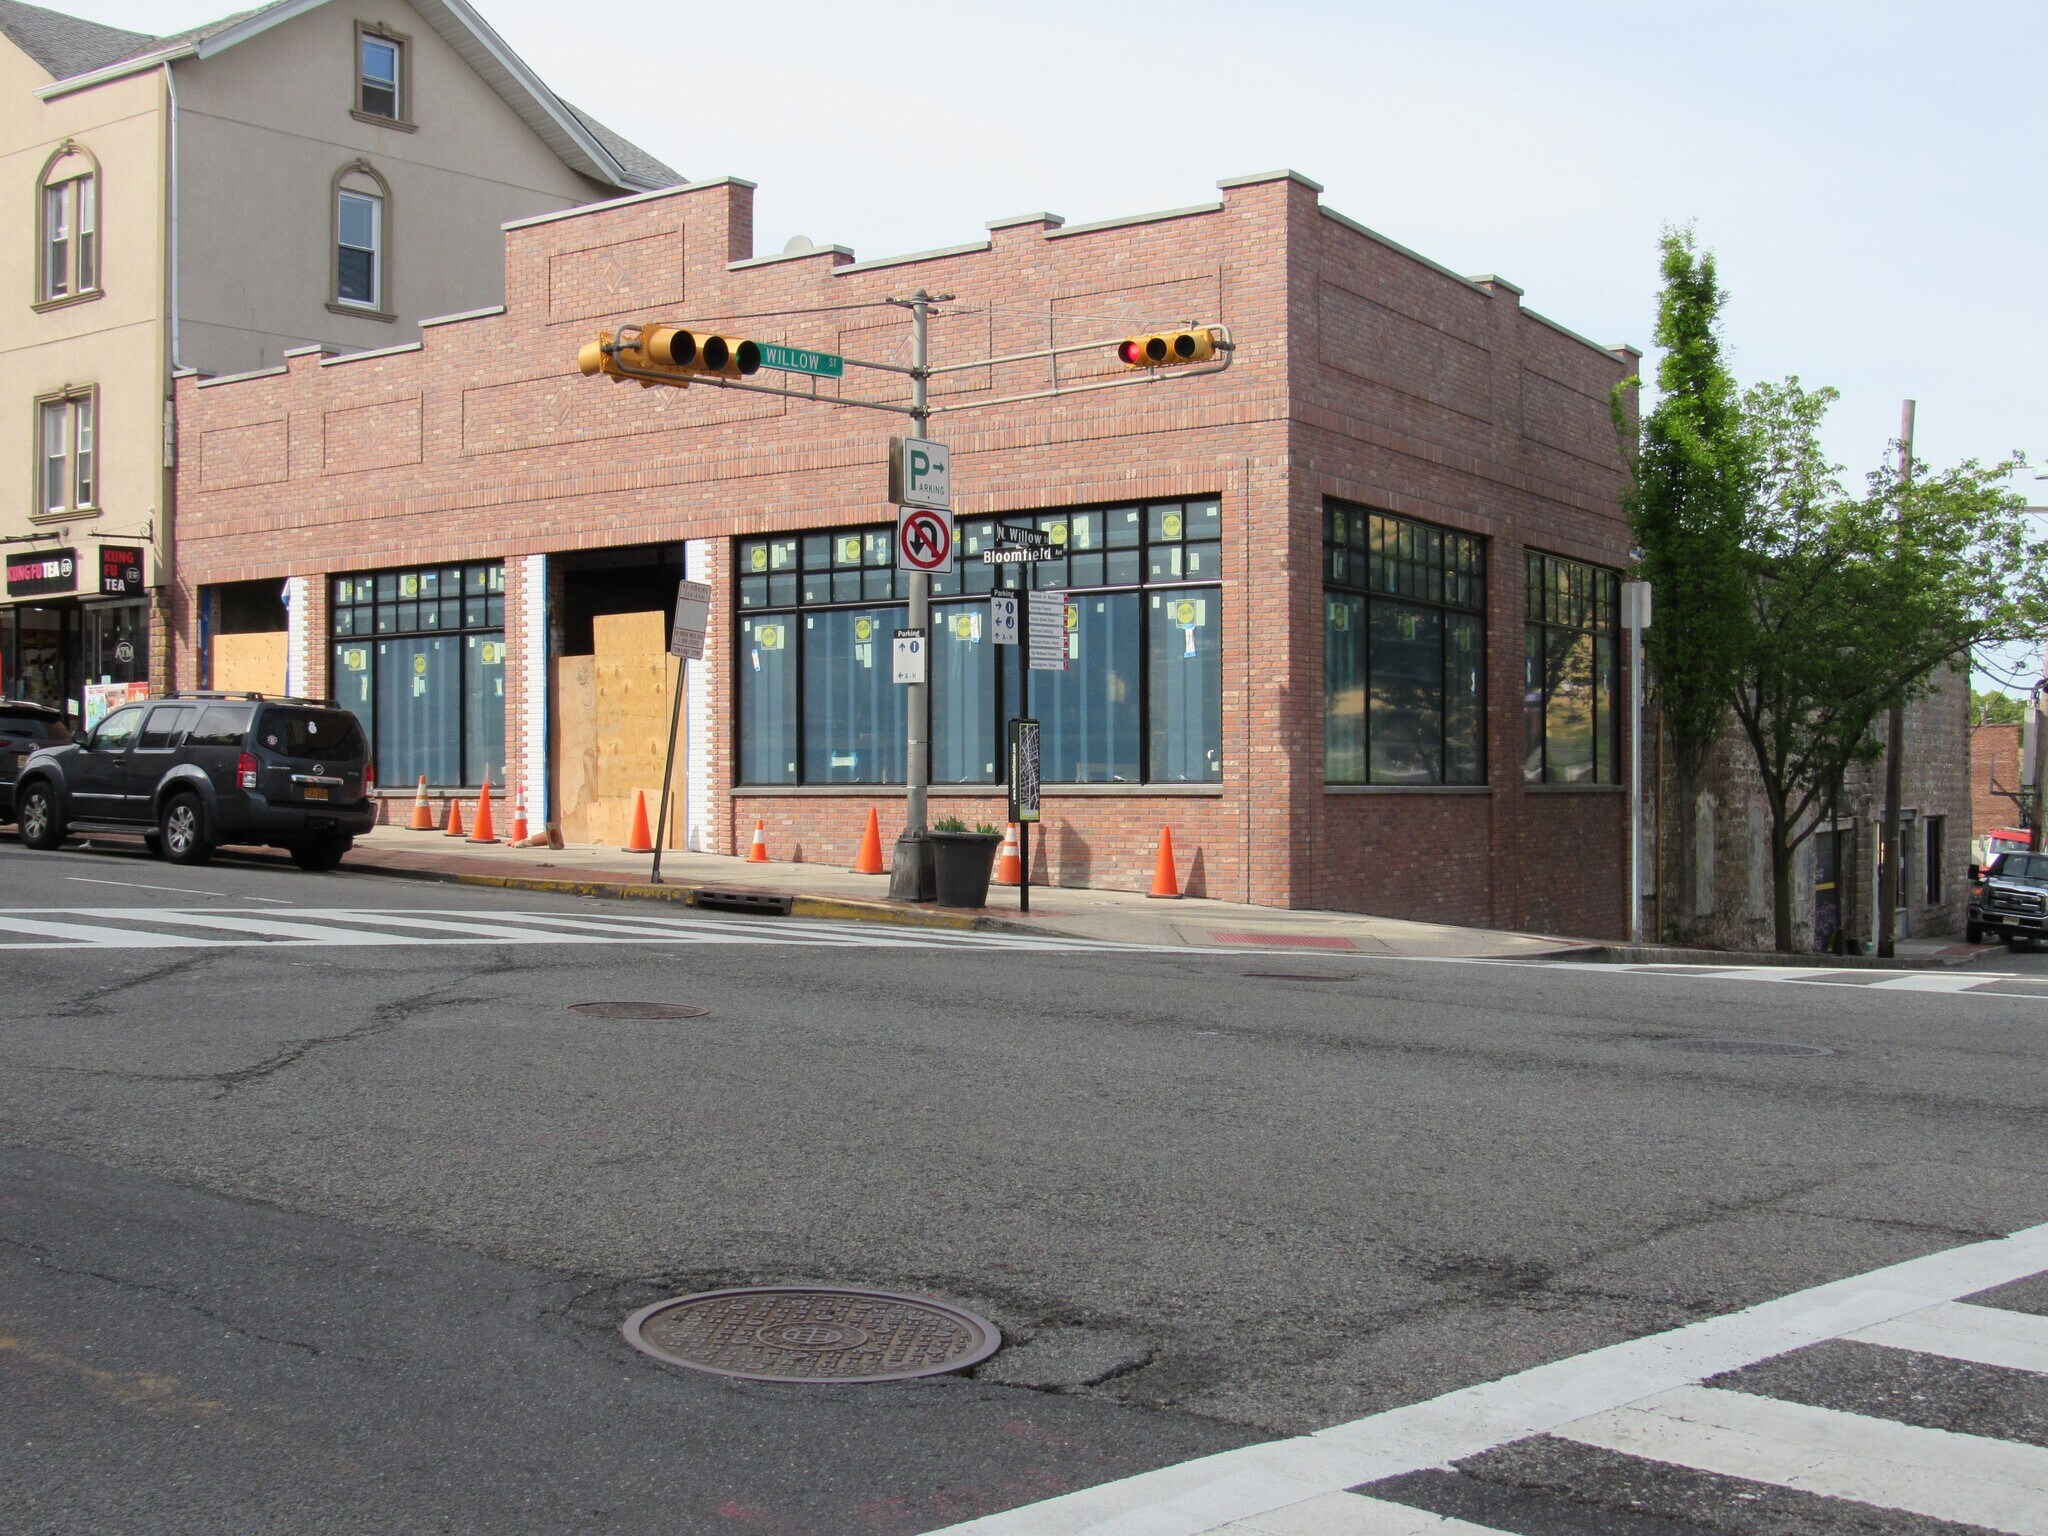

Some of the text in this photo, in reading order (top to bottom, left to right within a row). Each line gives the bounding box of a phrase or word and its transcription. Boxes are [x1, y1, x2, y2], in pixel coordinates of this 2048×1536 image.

[766, 348, 837, 370] WILLOW ST
[1010, 527, 1042, 544] Willow
[104, 550, 135, 564] KUNG
[984, 547, 1051, 563] Bloomfield
[42, 561, 60, 579] TEA
[104, 564, 119, 577] FU
[105, 578, 126, 592] TEA
[994, 589, 1015, 598] Parking
[898, 630, 920, 638] Parking
[115, 646, 134, 659] ATM
